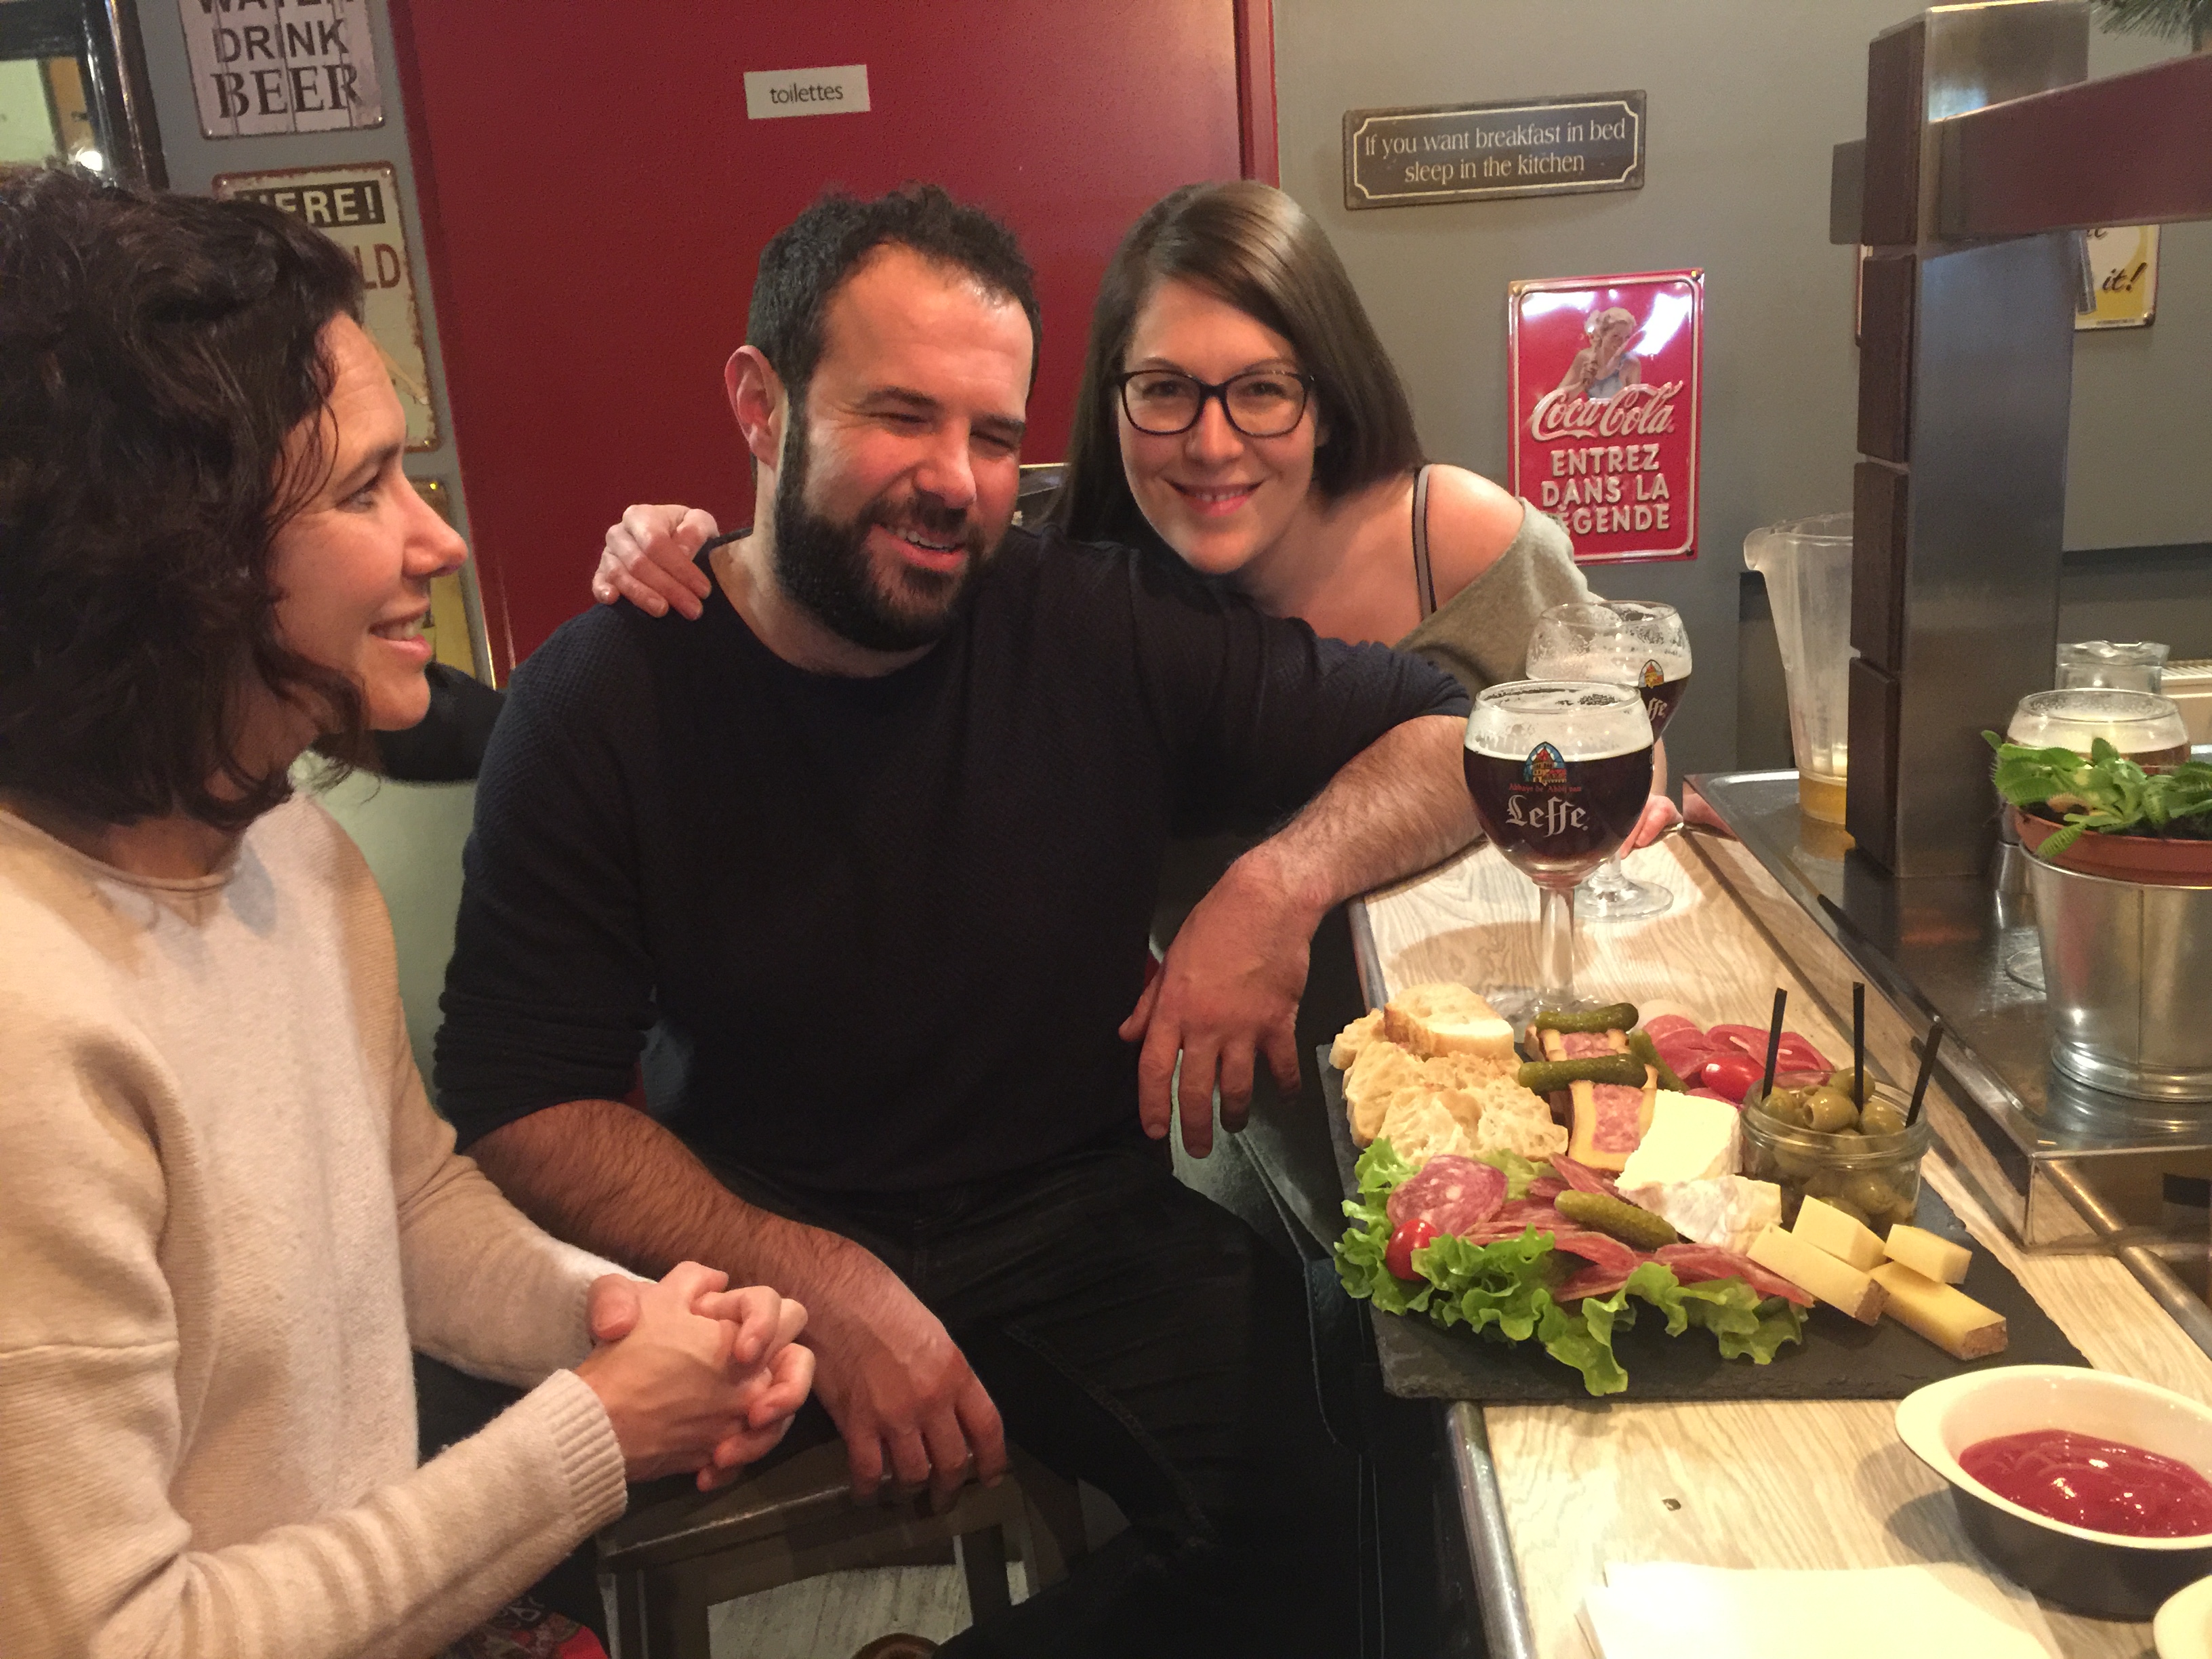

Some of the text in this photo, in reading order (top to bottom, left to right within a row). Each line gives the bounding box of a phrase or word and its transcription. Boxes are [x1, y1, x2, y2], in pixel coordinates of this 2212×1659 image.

[211, 18, 350, 63] DRINK
[210, 62, 364, 119] BEER
[769, 82, 844, 104] toilettes
[1365, 117, 1625, 160] If you want breakfast in bed
[1404, 152, 1584, 186] sleep in the kitchen
[243, 186, 377, 224] ERE!
[2102, 262, 2148, 293] it!
[1550, 443, 1660, 477] ENTREZ
[1541, 472, 1670, 508] DANS LA
